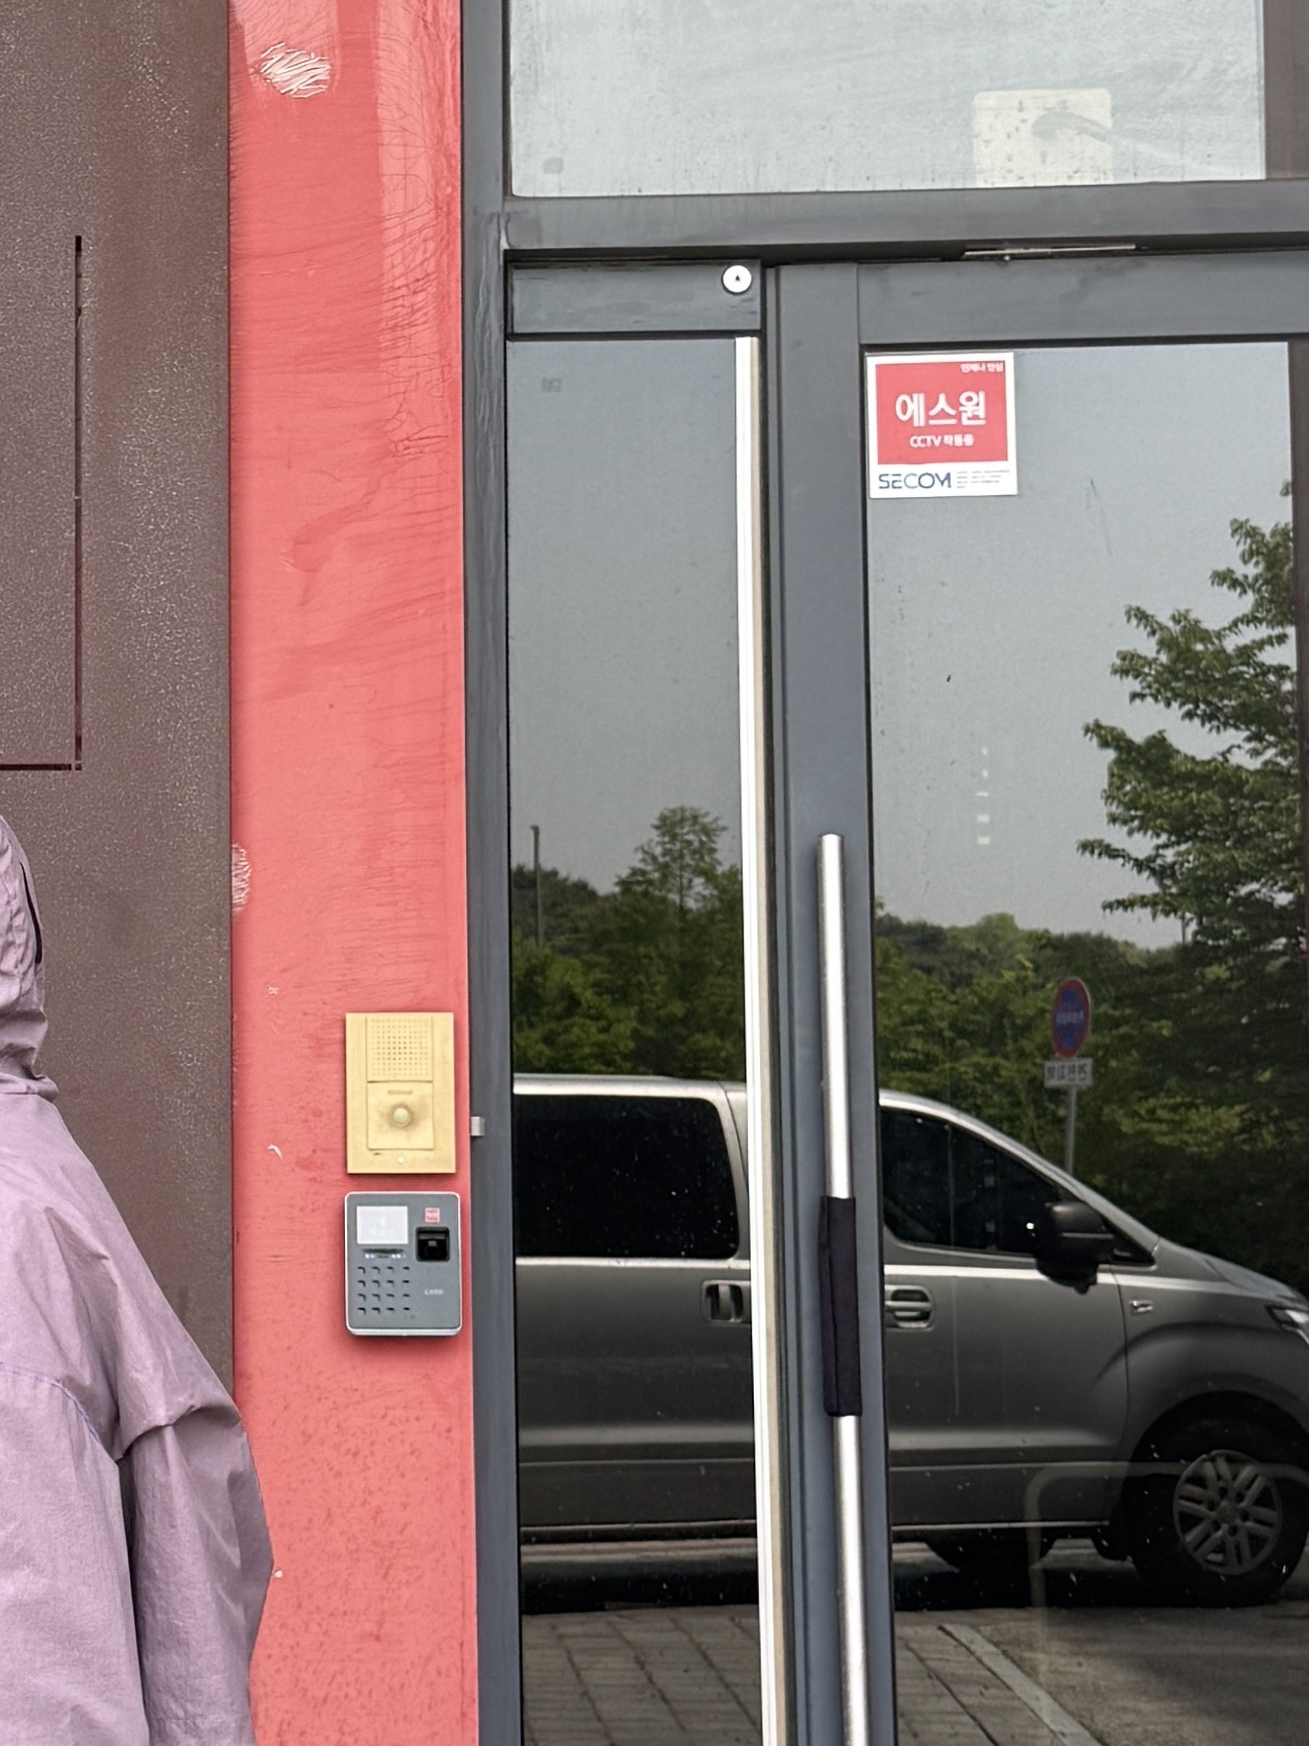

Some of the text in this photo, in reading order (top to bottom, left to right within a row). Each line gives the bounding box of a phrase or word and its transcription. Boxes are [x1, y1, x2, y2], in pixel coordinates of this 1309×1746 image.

[895, 391, 987, 427] 에스원
[909, 435, 942, 448] CCTV
[878, 472, 952, 489] SECOM
